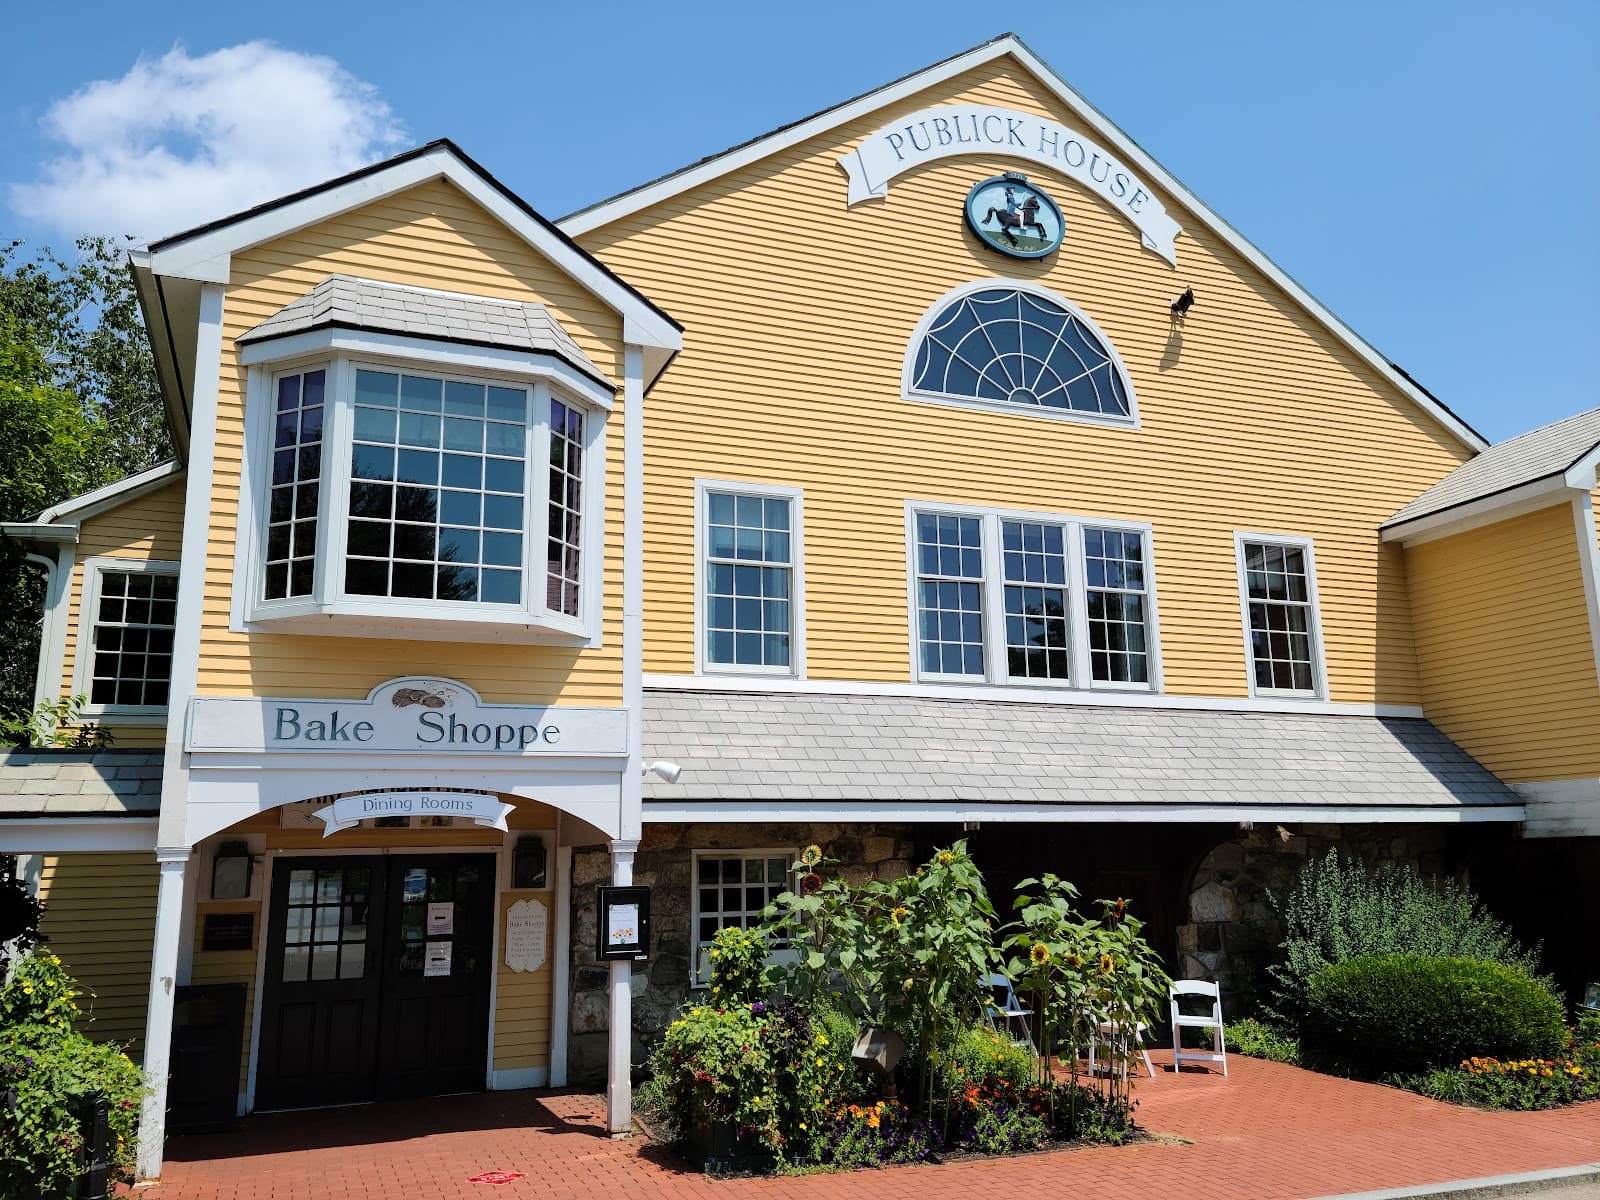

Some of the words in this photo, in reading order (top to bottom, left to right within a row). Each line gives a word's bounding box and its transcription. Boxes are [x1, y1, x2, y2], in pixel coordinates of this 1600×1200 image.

[885, 113, 1026, 162] PUBLICK
[1038, 126, 1150, 214] HOUSE
[273, 708, 374, 742] Bake
[416, 711, 560, 750] Shoppe
[363, 797, 412, 812] Dining
[421, 796, 473, 811] Rooms
